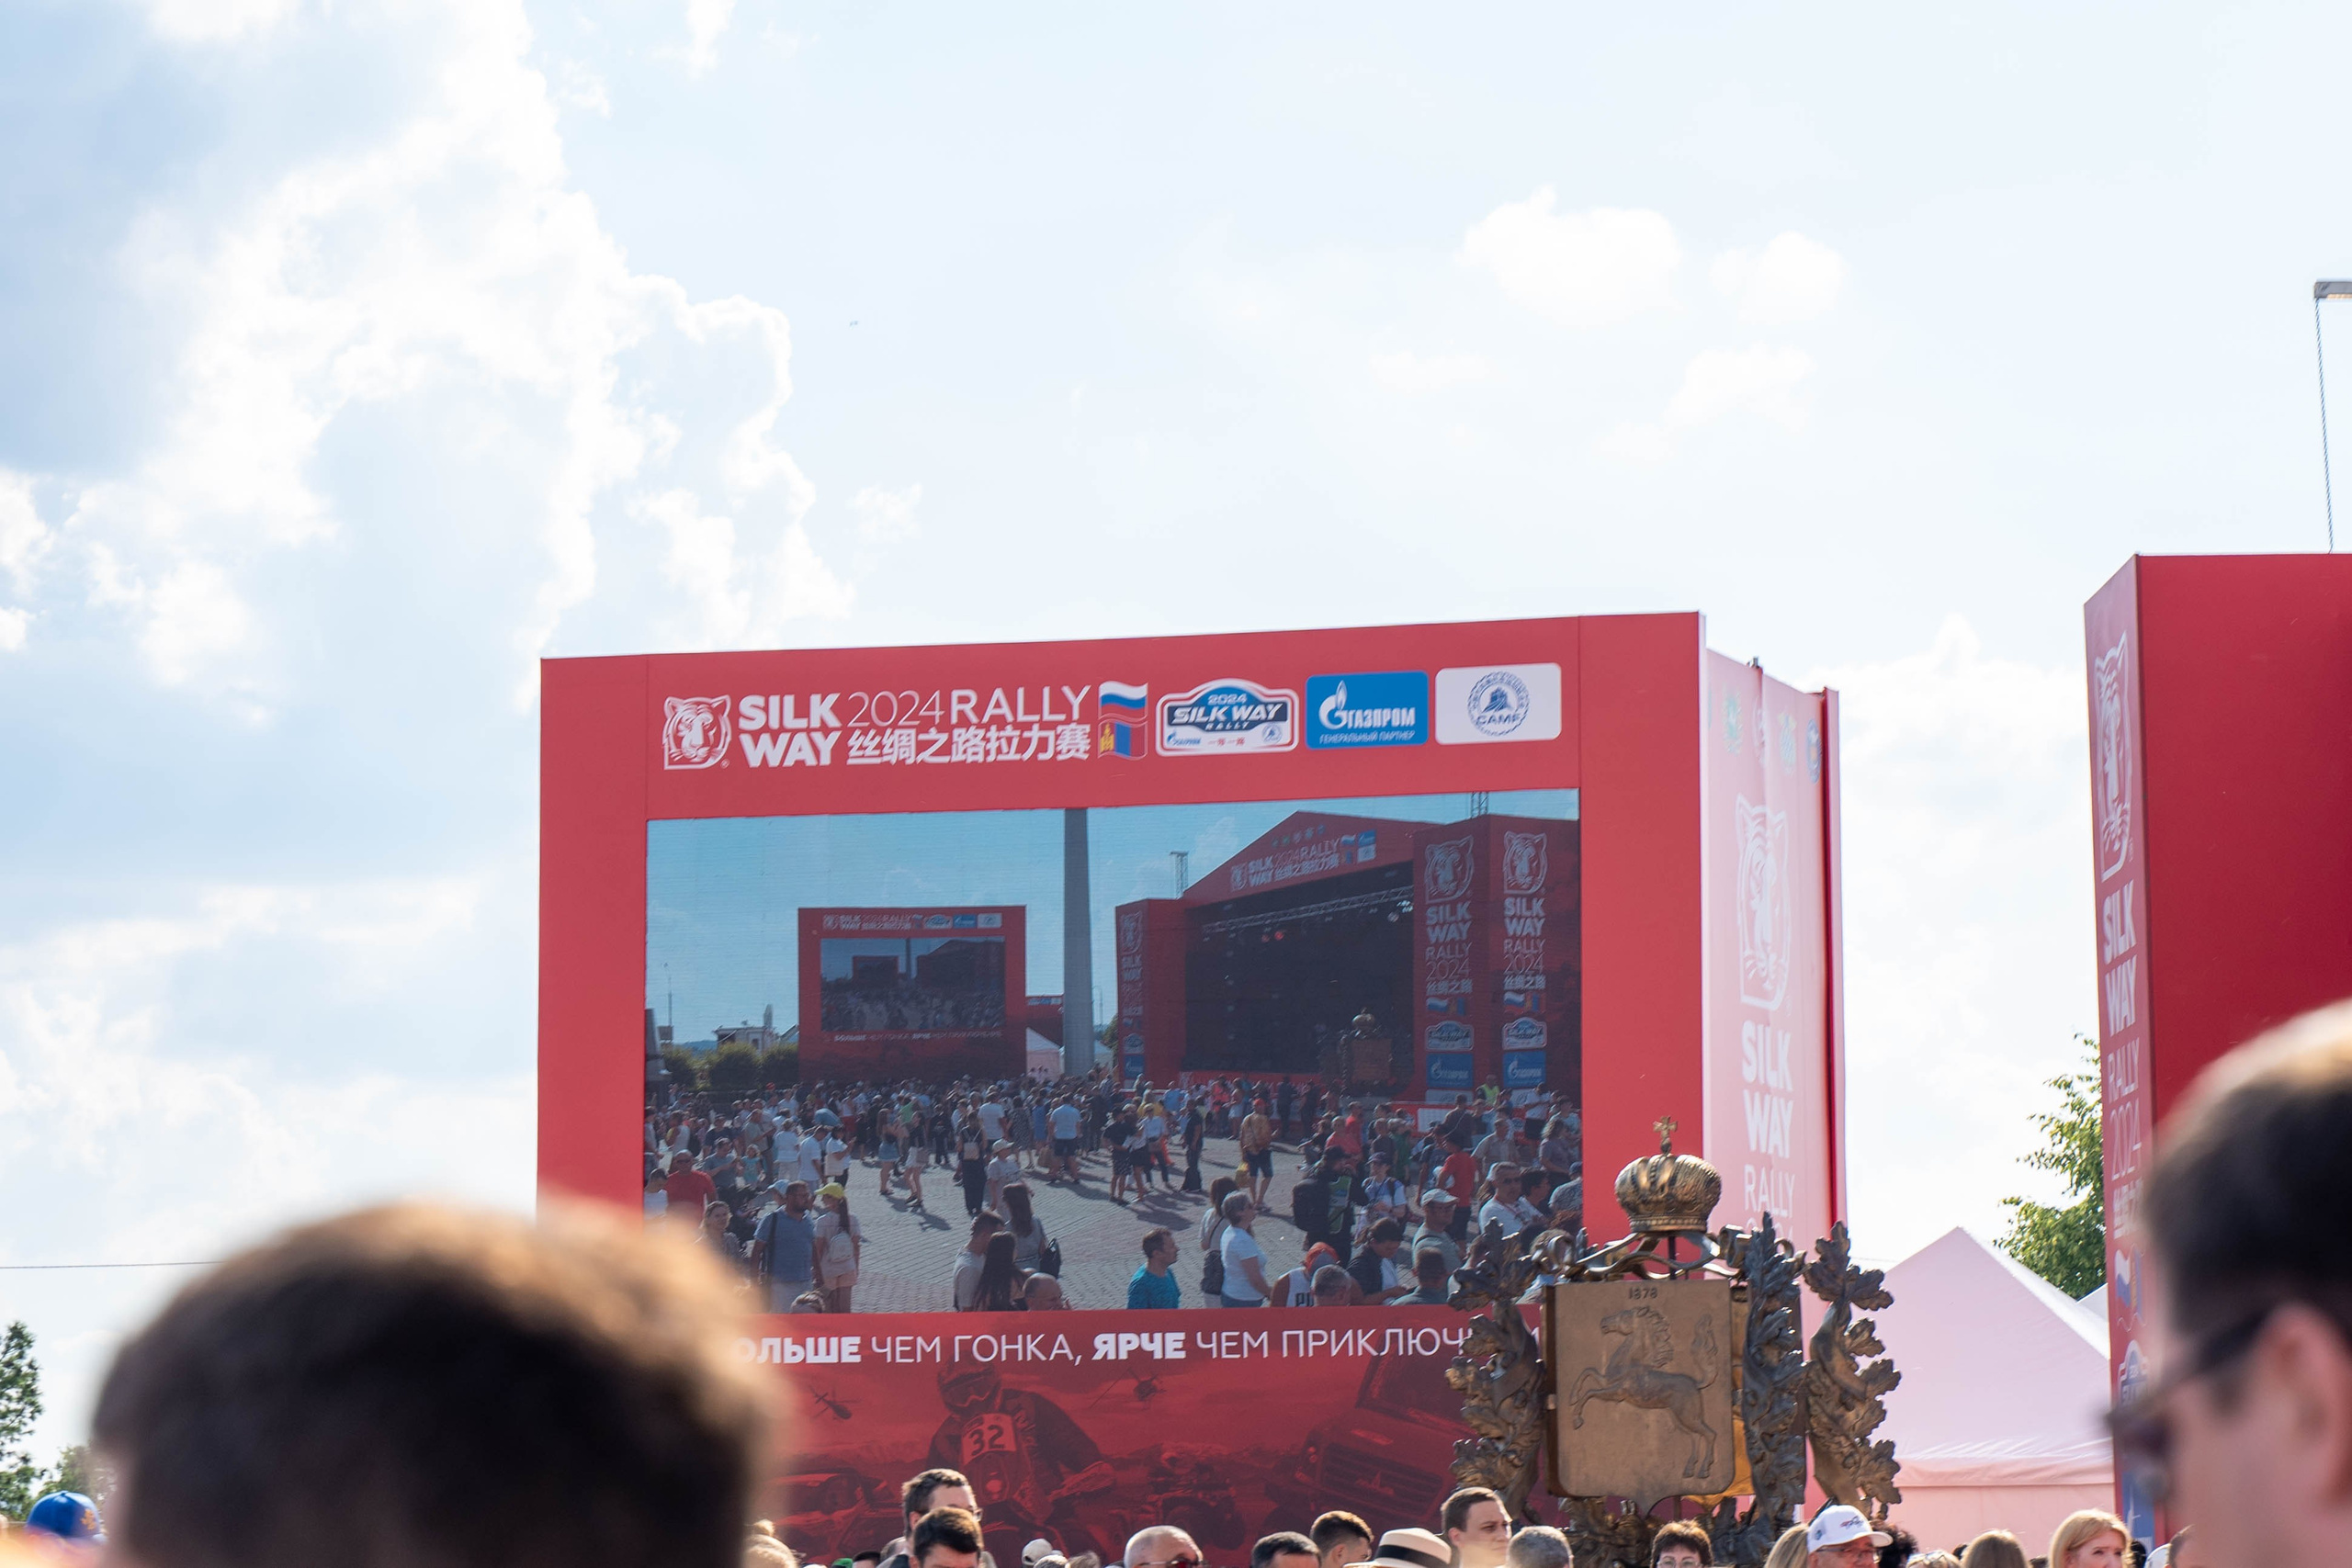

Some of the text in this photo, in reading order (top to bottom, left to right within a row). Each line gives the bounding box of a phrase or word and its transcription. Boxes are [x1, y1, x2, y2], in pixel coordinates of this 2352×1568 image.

[738, 684, 1091, 731] SILK 2024 RALLY
[1207, 693, 1248, 705] 2024
[1171, 703, 1283, 725] SILK WAY
[1204, 721, 1250, 731] RALLY
[1346, 707, 1416, 729] ГАЗПРОМ
[738, 730, 842, 768] WAY
[846, 722, 1091, 765] 丝绸之路拉力赛
[1426, 900, 1472, 926] SILK
[1503, 897, 1545, 917] SILK
[2103, 878, 2137, 964] SILK
[1427, 920, 1472, 944] WAY
[1504, 917, 1546, 937] WAY
[1426, 942, 1472, 961] RALLY
[1503, 938, 1545, 954] RALLY
[1426, 957, 1471, 981] 2024
[1503, 952, 1545, 975] 2024
[2105, 954, 2137, 1037] WAY
[1742, 1020, 1792, 1092] SILK
[2108, 1036, 2140, 1103] RALLY
[1743, 1089, 1793, 1158] WAY
[2109, 1097, 2142, 1181] 2024
[1744, 1164, 1795, 1218] RALLY
[732, 1327, 1473, 1366] ОЛЬШЕ ЧЕМ ГОНКА, ЯРЧЕ ЧЕМ ПРИКЛЮЧ
[968, 1425, 1004, 1456] 32
